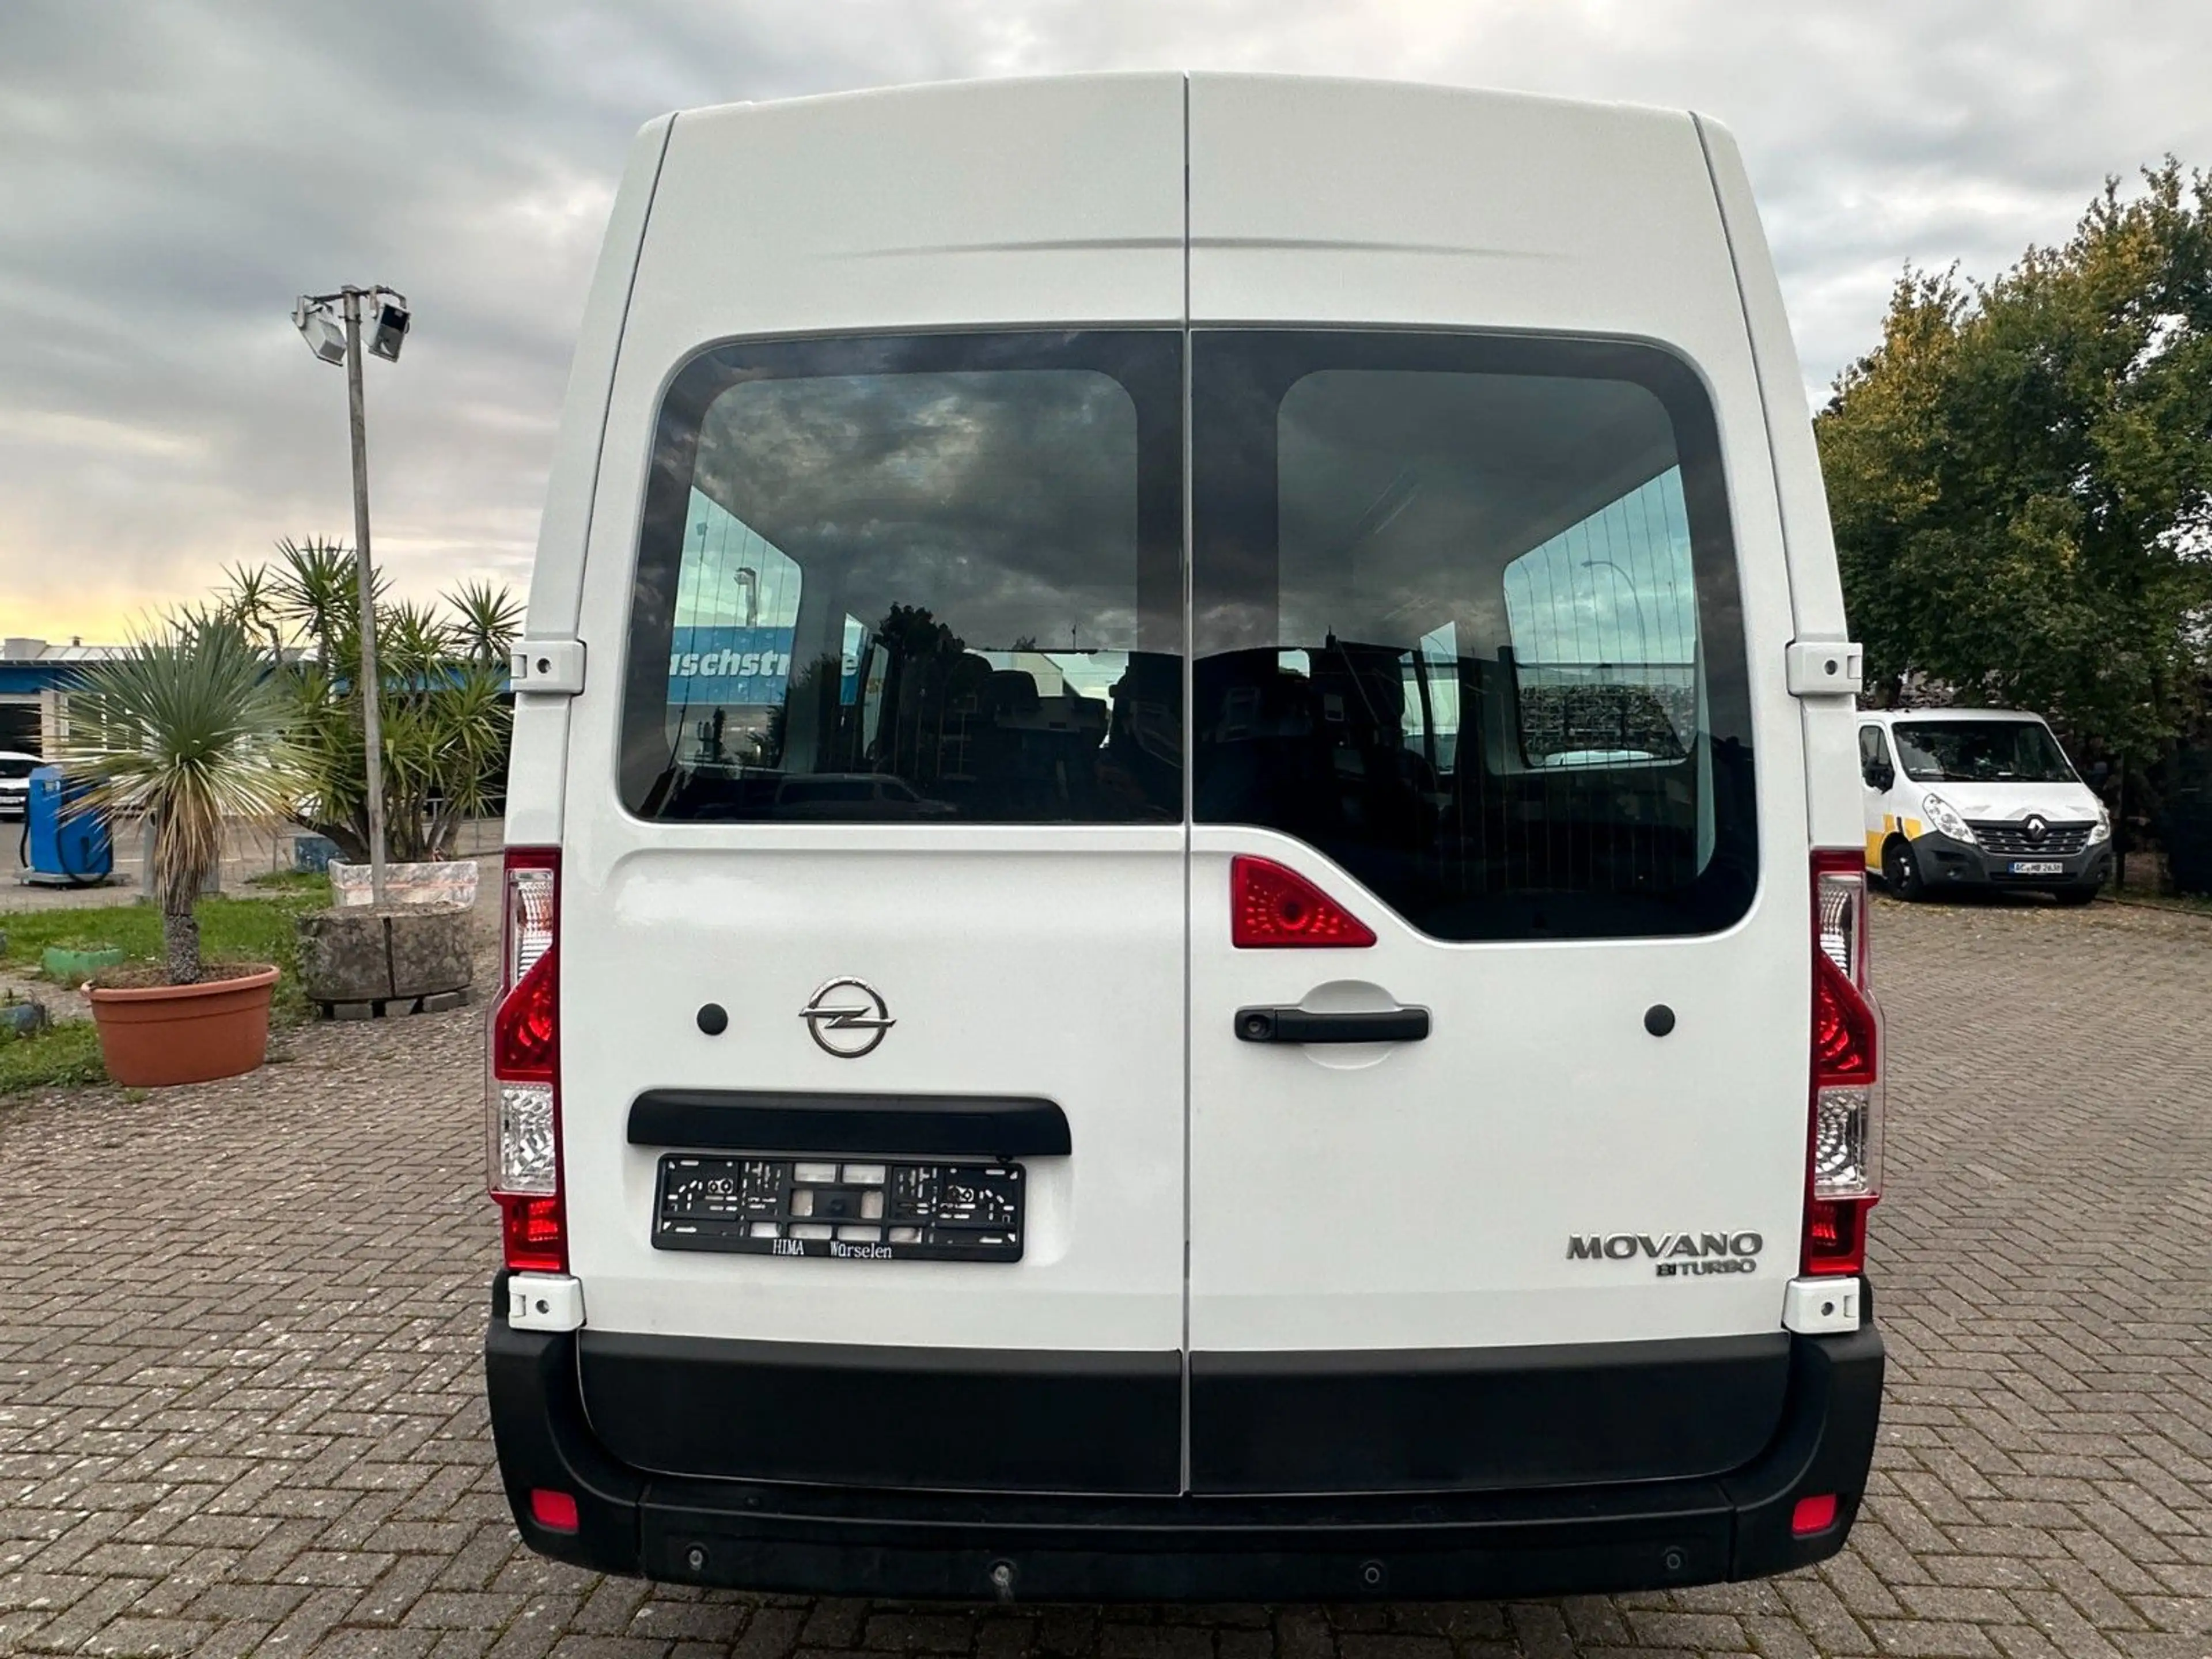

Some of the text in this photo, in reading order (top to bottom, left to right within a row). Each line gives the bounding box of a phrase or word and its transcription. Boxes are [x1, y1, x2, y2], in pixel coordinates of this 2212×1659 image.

[772, 1238, 804, 1255] HIMA
[1566, 1230, 1763, 1260] MOVANO
[1655, 1257, 1757, 1277] BITURBO
